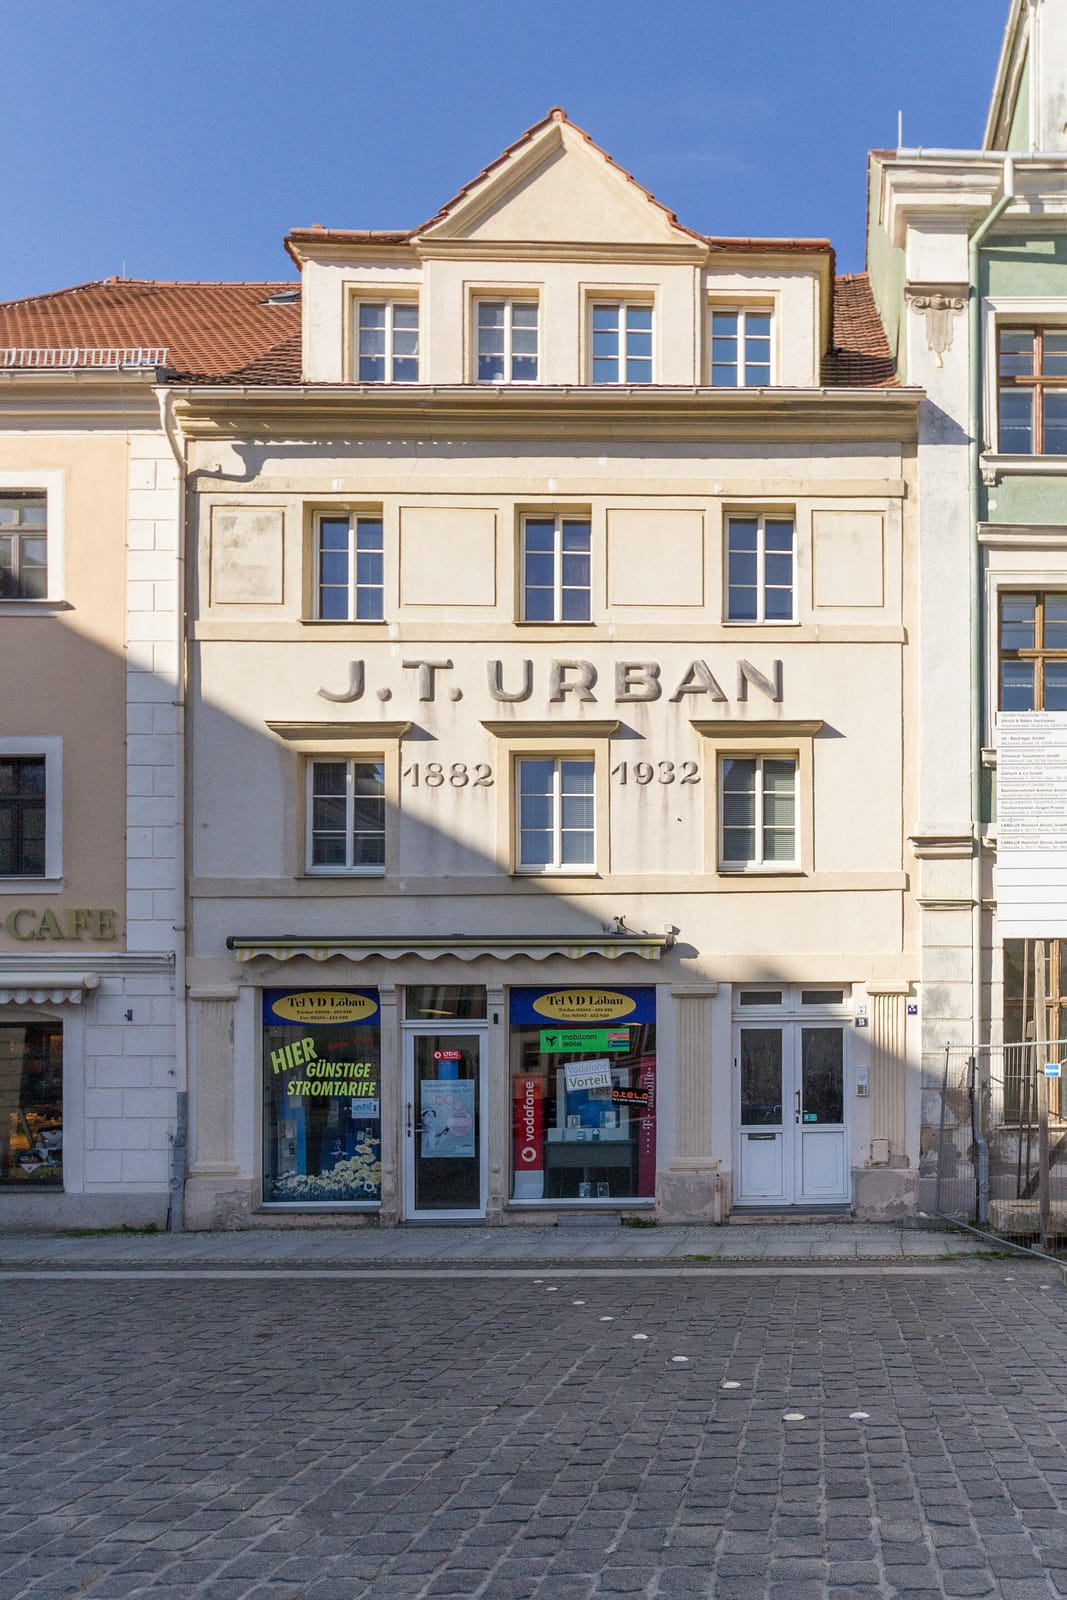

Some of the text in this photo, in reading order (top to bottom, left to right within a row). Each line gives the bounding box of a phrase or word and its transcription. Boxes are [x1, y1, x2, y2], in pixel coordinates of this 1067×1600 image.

[403, 762, 495, 789] 1882
[611, 760, 702, 787] 1932
[6, 908, 116, 941] CAFE
[287, 997, 365, 1008] Tel VD Löbau
[546, 995, 623, 1005] Tel VD Löbau
[270, 1036, 319, 1074] HIER
[306, 1060, 372, 1078] GÜNSTIGE
[567, 1062, 608, 1074] Vodafone
[287, 1080, 376, 1097] STROMTARIFE
[568, 1073, 609, 1088] Vorteil
[523, 1081, 535, 1142] vodafone
